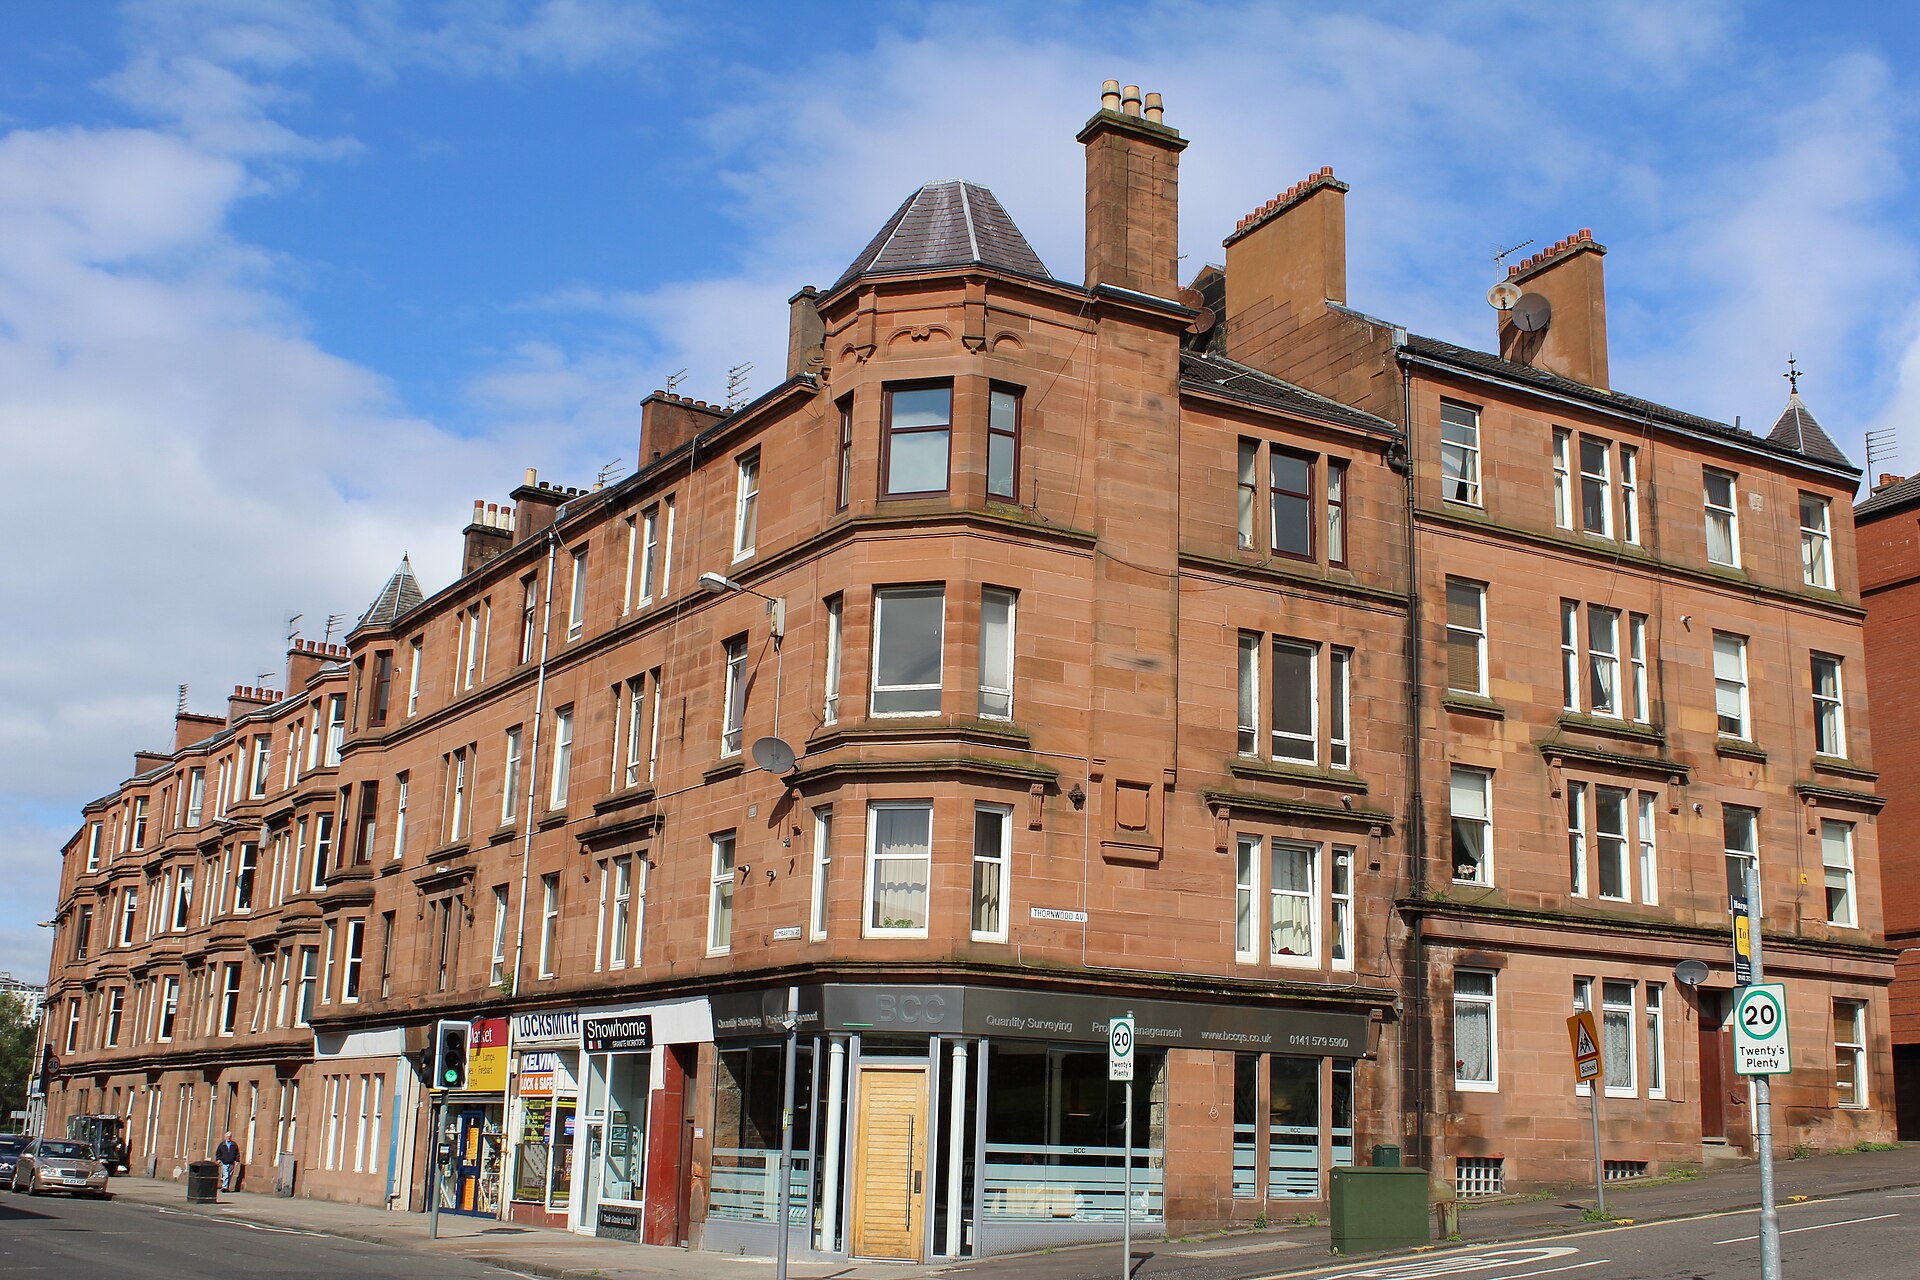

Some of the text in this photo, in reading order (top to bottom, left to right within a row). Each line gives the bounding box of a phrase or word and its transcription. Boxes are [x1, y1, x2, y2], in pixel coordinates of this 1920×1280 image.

[1034, 909, 1084, 921] THORNWOOD AV
[876, 994, 945, 1024] BCC
[1745, 1004, 1774, 1026] 20
[519, 1011, 579, 1037] LOCKSMITH
[587, 1018, 647, 1039] Showhome
[717, 1017, 737, 1029] Quantity
[738, 1016, 761, 1028] Surveying
[986, 1015, 1349, 1048] Quantity Surveying Proj anagement www.bccqs.co.uk 0141 579 5900
[1114, 1032, 1129, 1046] 20
[1739, 1045, 1785, 1057] Twenty's
[48, 1060, 59, 1070] 30
[522, 1053, 555, 1071] KELVIN
[1111, 1060, 1132, 1069] Twenty's
[1581, 1063, 1597, 1074] School
[1746, 1058, 1779, 1069] Plenty
[1113, 1069, 1129, 1078] Plenty
[521, 1077, 534, 1091] LOCK
[540, 1075, 553, 1089] SAFE
